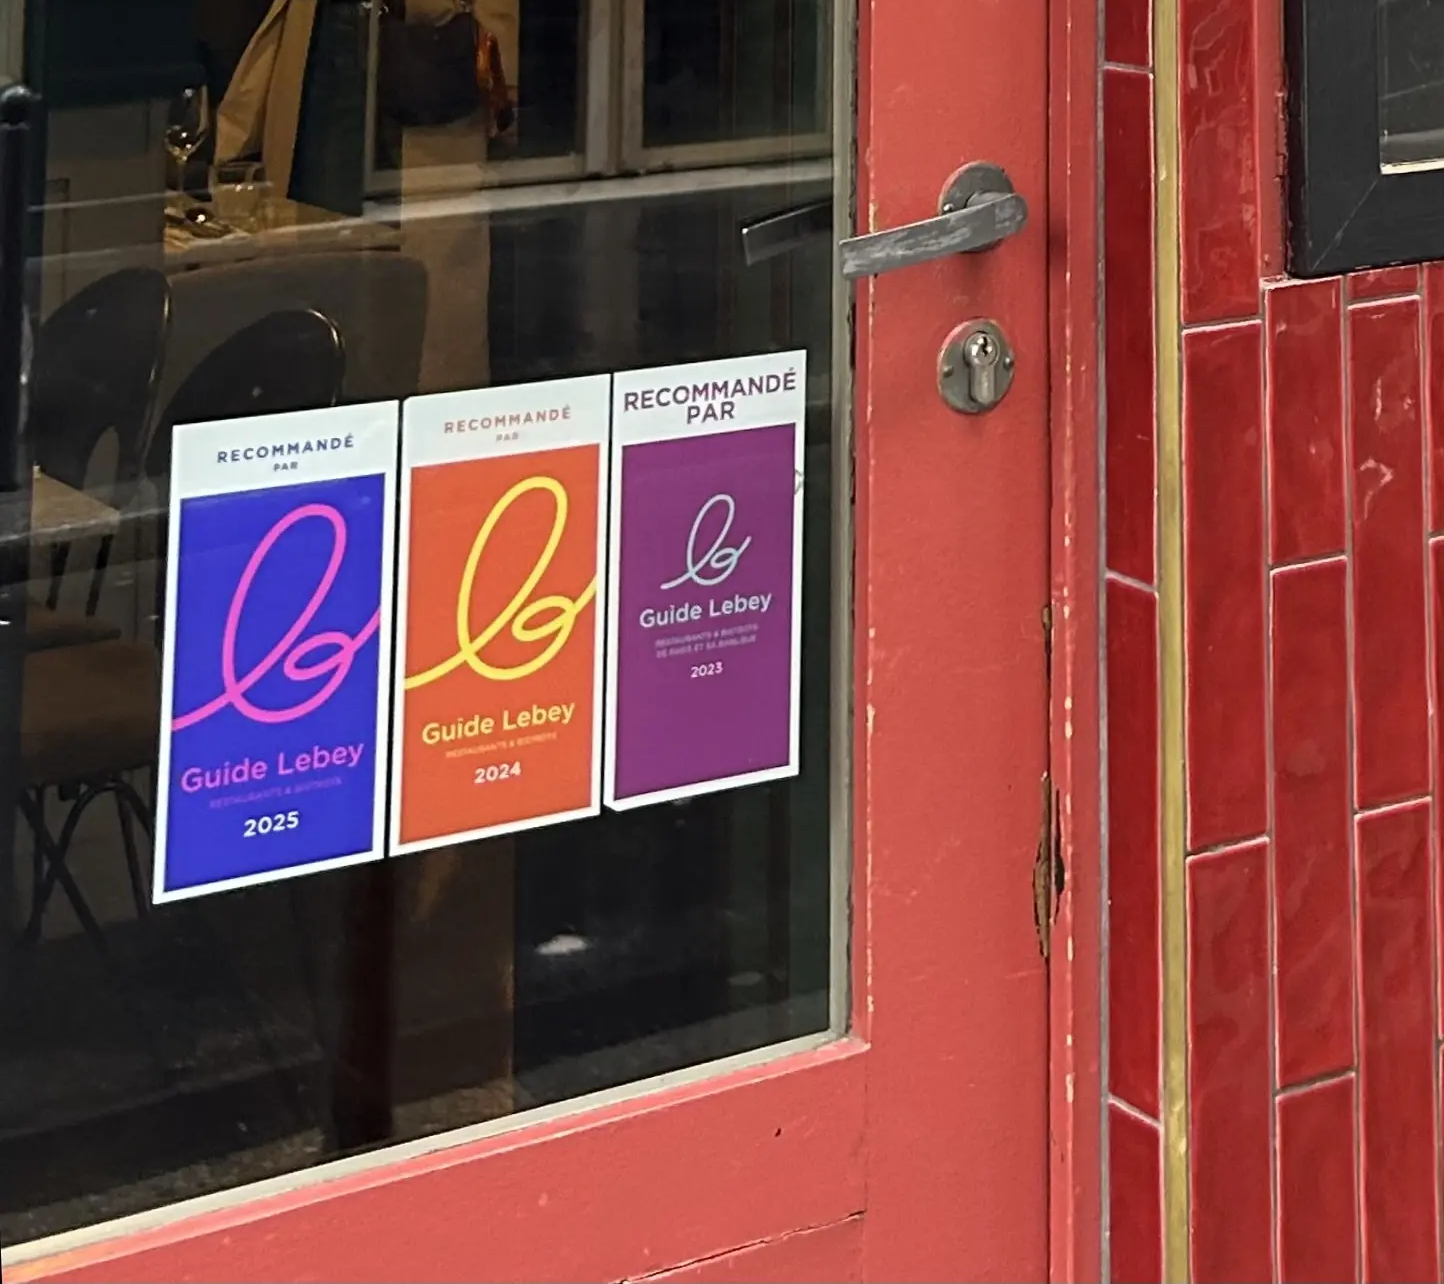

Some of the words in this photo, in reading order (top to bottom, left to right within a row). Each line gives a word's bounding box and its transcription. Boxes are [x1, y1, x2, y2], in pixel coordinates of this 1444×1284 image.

[623, 367, 797, 412] RECOMMANDÉ
[443, 404, 572, 434] RECOMMANDÉ
[686, 401, 736, 424] PAR
[216, 432, 355, 464] RECOMMANDÉ
[495, 431, 519, 443] PAR
[273, 460, 299, 472] PAR
[639, 602, 703, 628] Guide
[708, 592, 772, 618] Lebey
[690, 661, 724, 679] 2023
[421, 714, 495, 745] Guide
[502, 702, 576, 731] Lebey
[180, 757, 269, 793] Guide
[277, 742, 365, 776] Lebey
[473, 760, 522, 784] 2024
[242, 810, 300, 838] 2025
